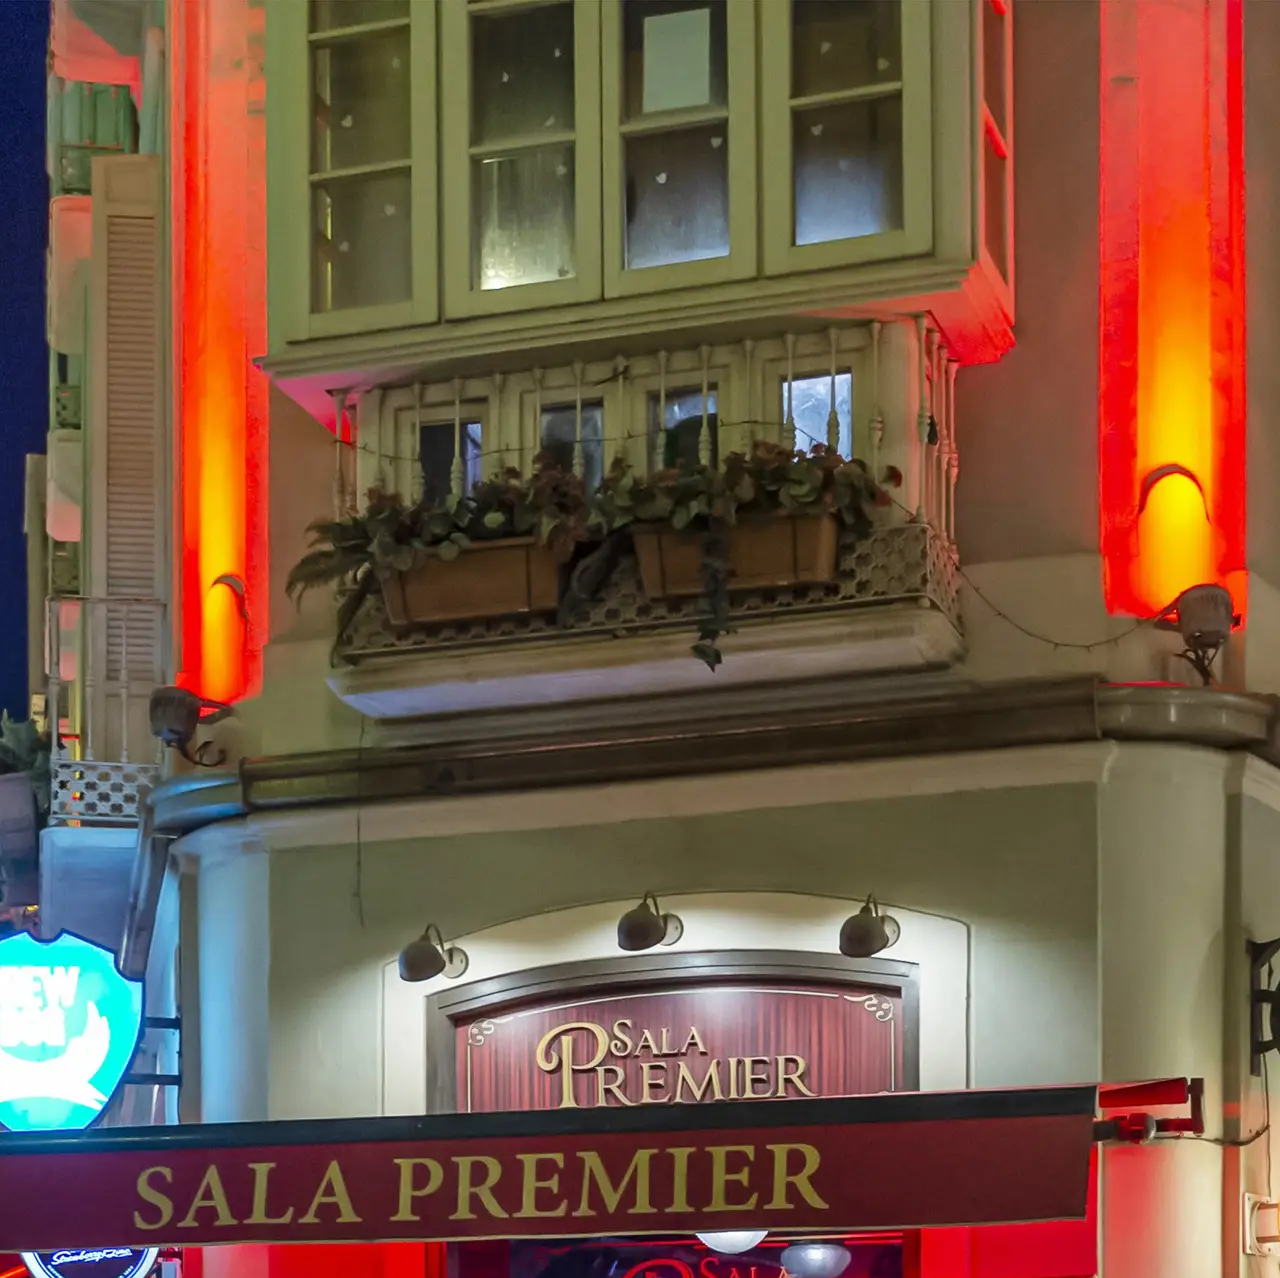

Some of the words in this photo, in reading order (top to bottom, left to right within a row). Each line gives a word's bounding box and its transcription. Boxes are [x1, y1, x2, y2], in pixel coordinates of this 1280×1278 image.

[536, 1022, 820, 1108] PREMIER
[610, 1019, 708, 1057] SALA
[133, 1159, 362, 1230] SALA
[389, 1143, 830, 1222] PREMIER
